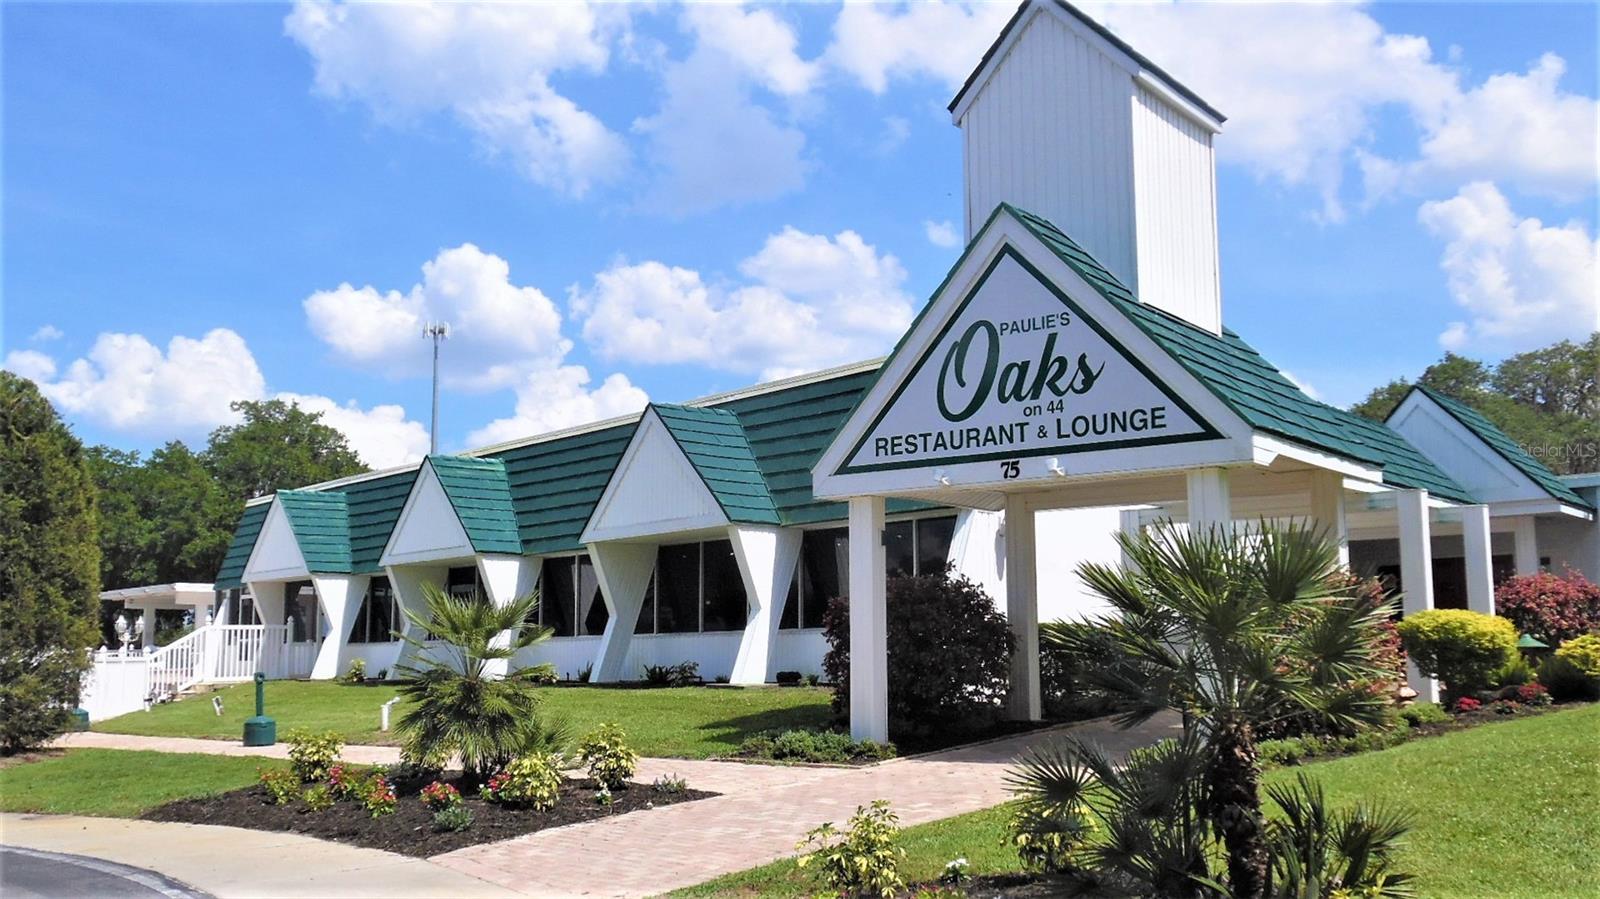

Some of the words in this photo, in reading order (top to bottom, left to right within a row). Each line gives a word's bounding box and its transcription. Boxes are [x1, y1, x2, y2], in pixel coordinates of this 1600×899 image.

[1000, 311, 1071, 336] PAULIE'S
[937, 319, 1105, 422] Oaks
[1023, 404, 1043, 417] on
[1047, 399, 1064, 415] 44
[875, 422, 1029, 457] RESTAURANT
[1037, 425, 1048, 439] &
[1056, 406, 1167, 439] LOUNGE
[1000, 460, 1020, 479] 75
